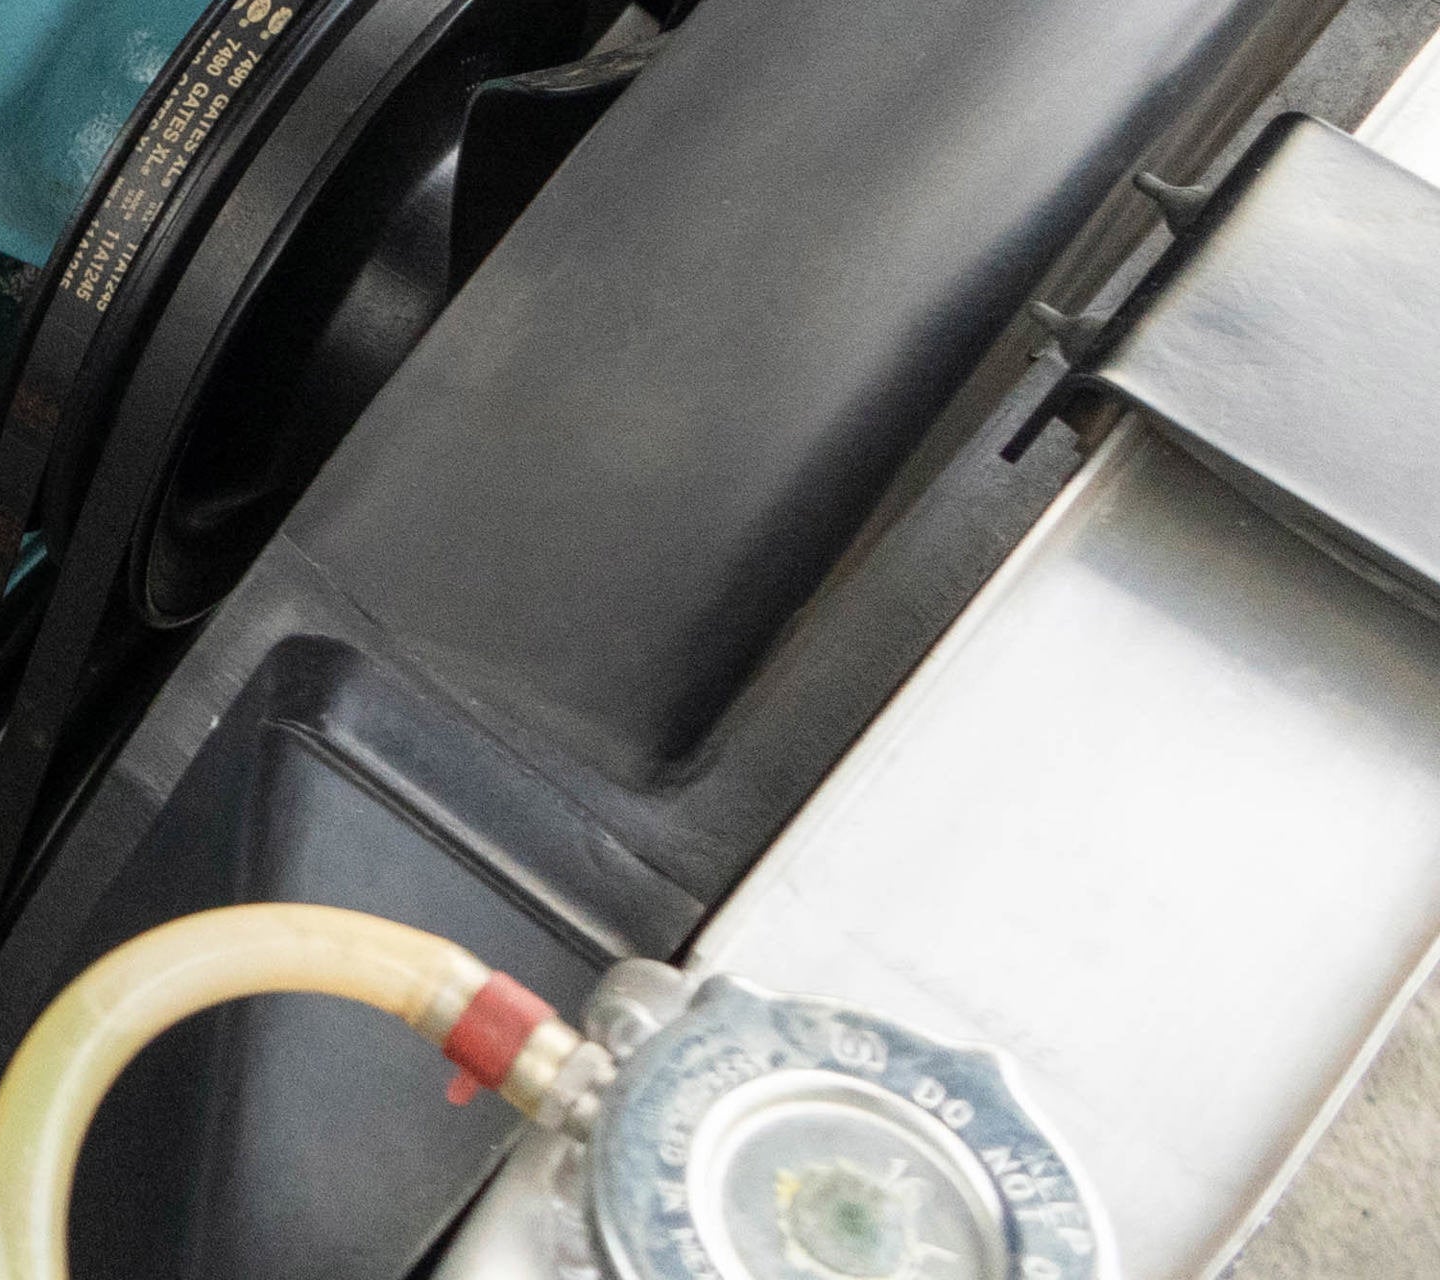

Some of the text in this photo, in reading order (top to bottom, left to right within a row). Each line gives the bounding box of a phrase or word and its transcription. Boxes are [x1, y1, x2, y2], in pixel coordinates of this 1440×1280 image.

[204, 35, 242, 79] 7490
[224, 47, 262, 89] 7490
[160, 79, 211, 145] GATES
[181, 90, 230, 156] GATES
[73, 227, 121, 302] 11A1245
[911, 1075, 976, 1130] DO
